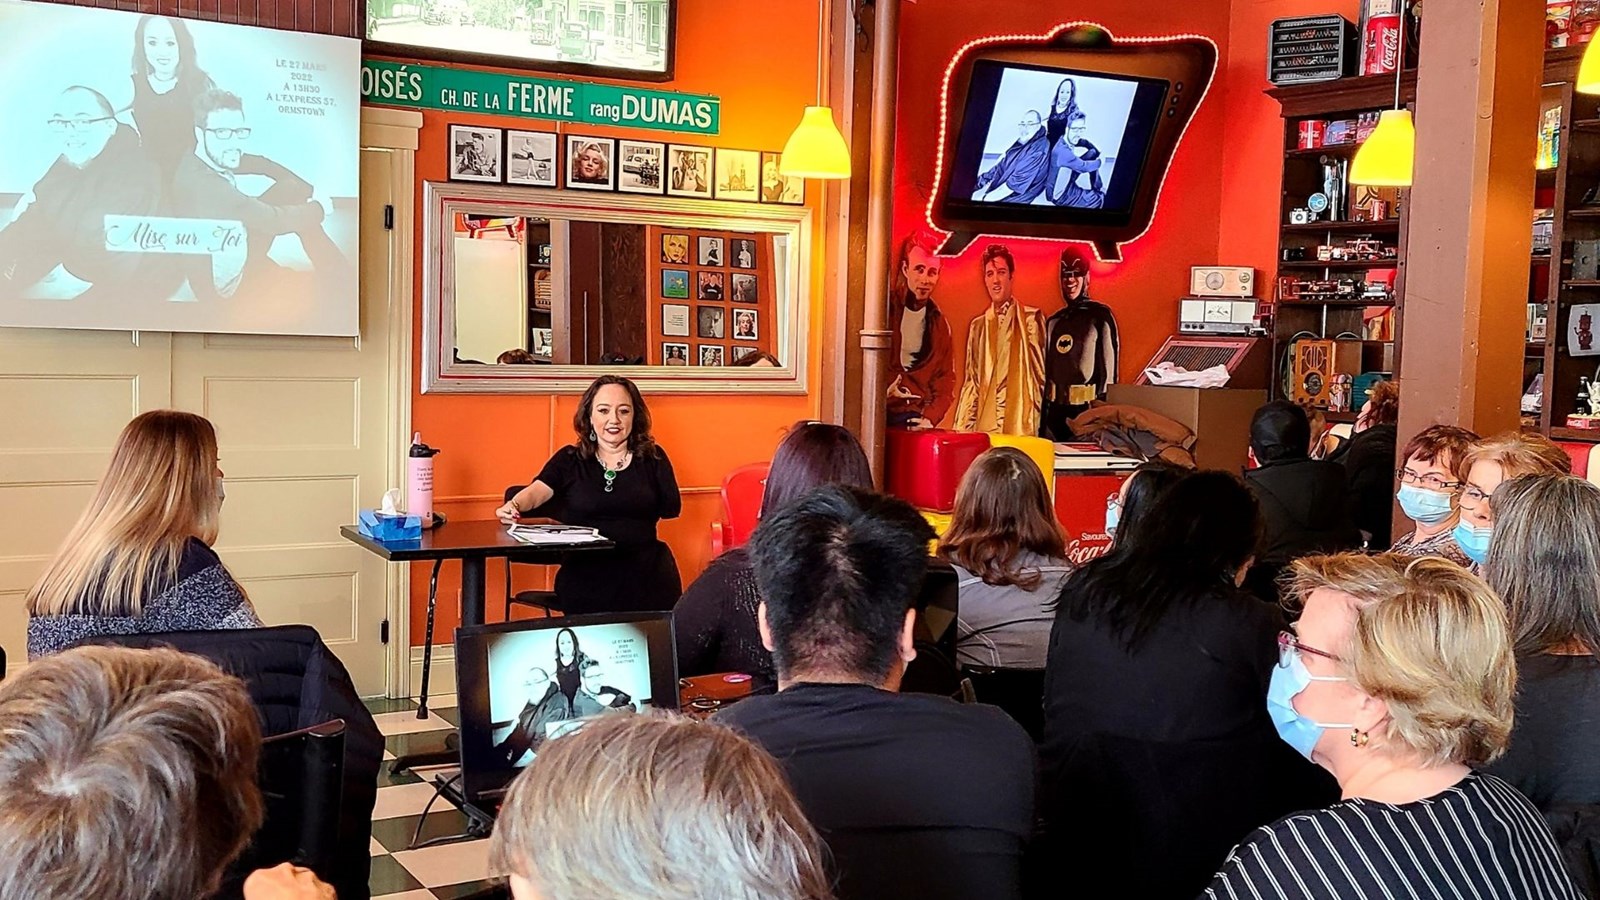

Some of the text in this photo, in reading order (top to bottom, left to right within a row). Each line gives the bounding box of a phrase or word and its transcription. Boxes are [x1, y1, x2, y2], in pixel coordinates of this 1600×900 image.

[276, 59, 327, 71] LE 27 MARS
[290, 72, 313, 82] 2022
[441, 82, 574, 117] CH. DE LA FERME
[278, 105, 326, 116] ORMSTOWN
[590, 94, 711, 128] rang DUMAS
[105, 222, 168, 251] Mise
[175, 232, 200, 247] sur
